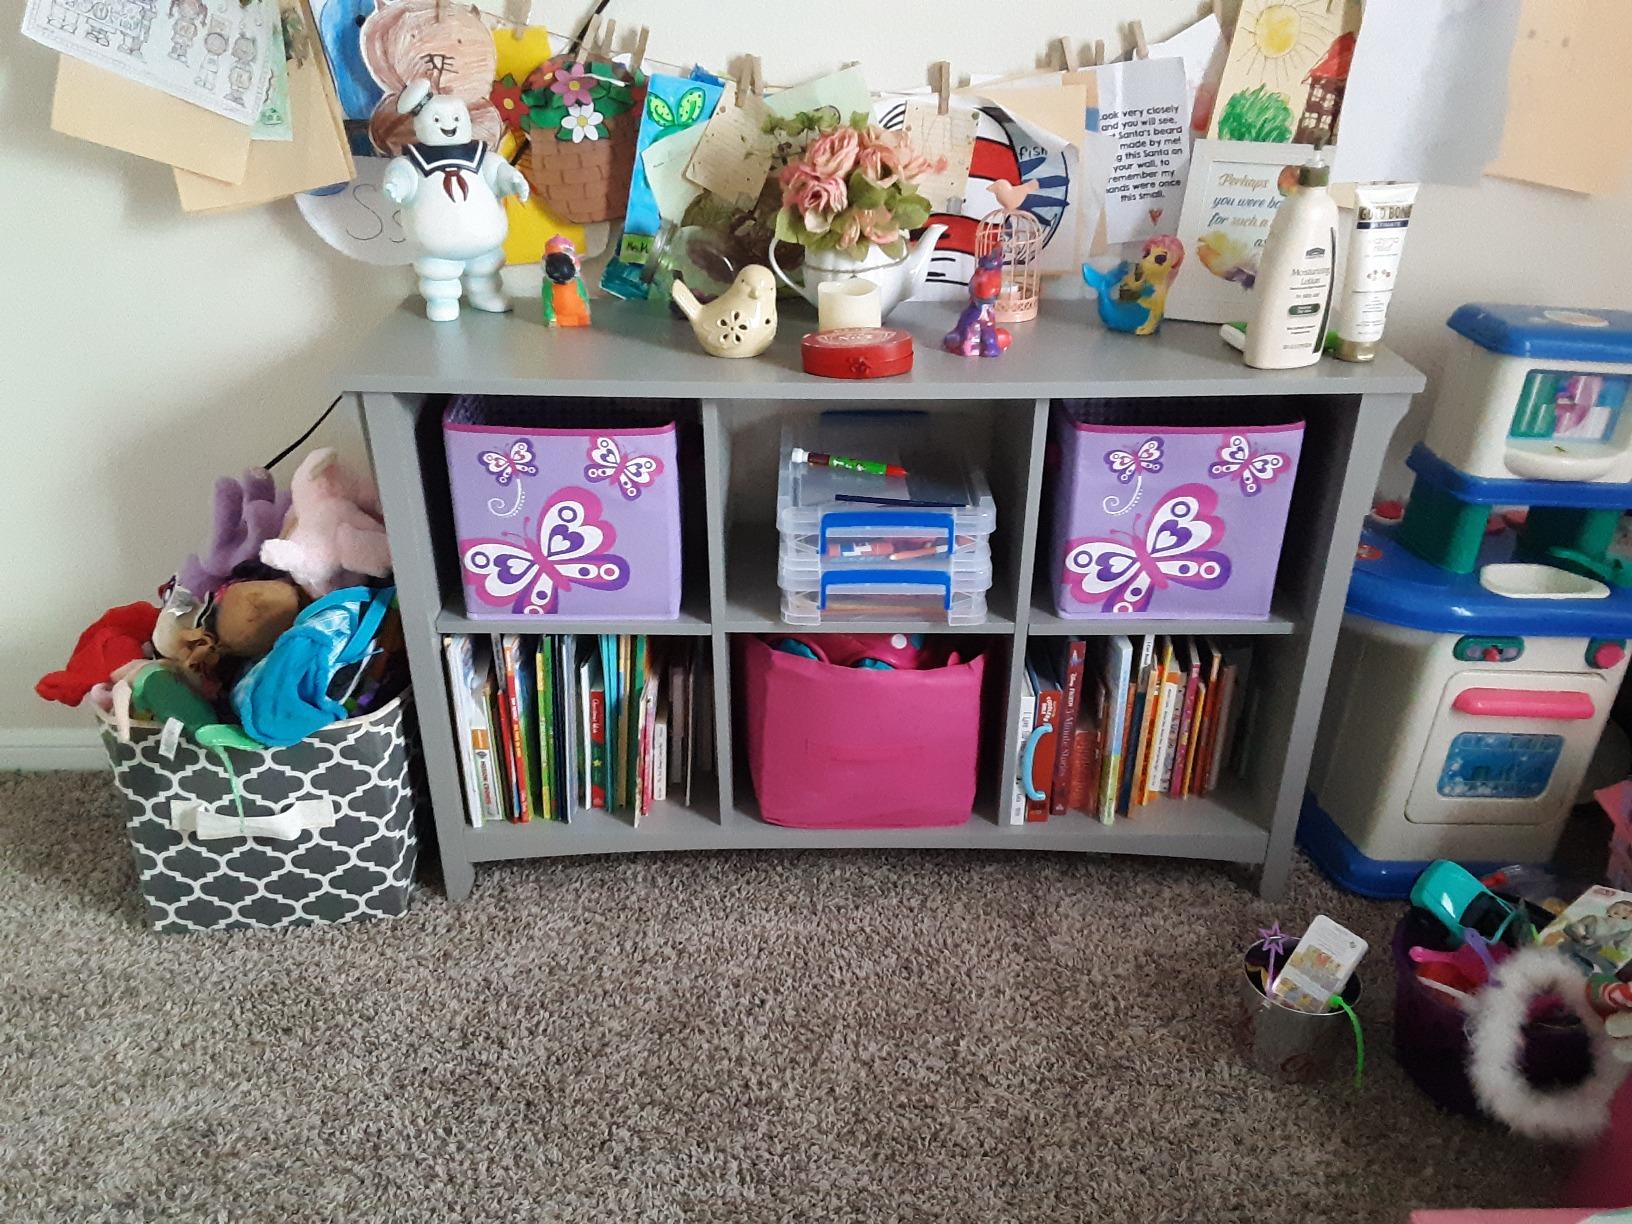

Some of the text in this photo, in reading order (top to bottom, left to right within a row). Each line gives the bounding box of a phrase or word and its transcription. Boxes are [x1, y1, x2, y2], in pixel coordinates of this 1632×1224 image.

[1099, 103, 1179, 121] ook very closely
[1101, 122, 1119, 131] and
[1121, 121, 1139, 130] you
[1141, 117, 1156, 126] will
[1118, 125, 1183, 139] Santa's beard
[1120, 140, 1147, 150] made
[1149, 139, 1161, 148] by
[1018, 146, 1049, 161] fish
[1125, 151, 1141, 160] this
[1143, 148, 1169, 158] Santa
[1113, 163, 1134, 174] your
[1160, 159, 1170, 167] to
[1108, 170, 1176, 183] remember my
[1217, 173, 1270, 192] Perhaps
[1132, 181, 1156, 191] were
[1158, 180, 1182, 188] once
[1120, 194, 1137, 203] this
[1211, 196, 1236, 209] you
[1237, 197, 1267, 208] were
[1207, 212, 1230, 228] for
